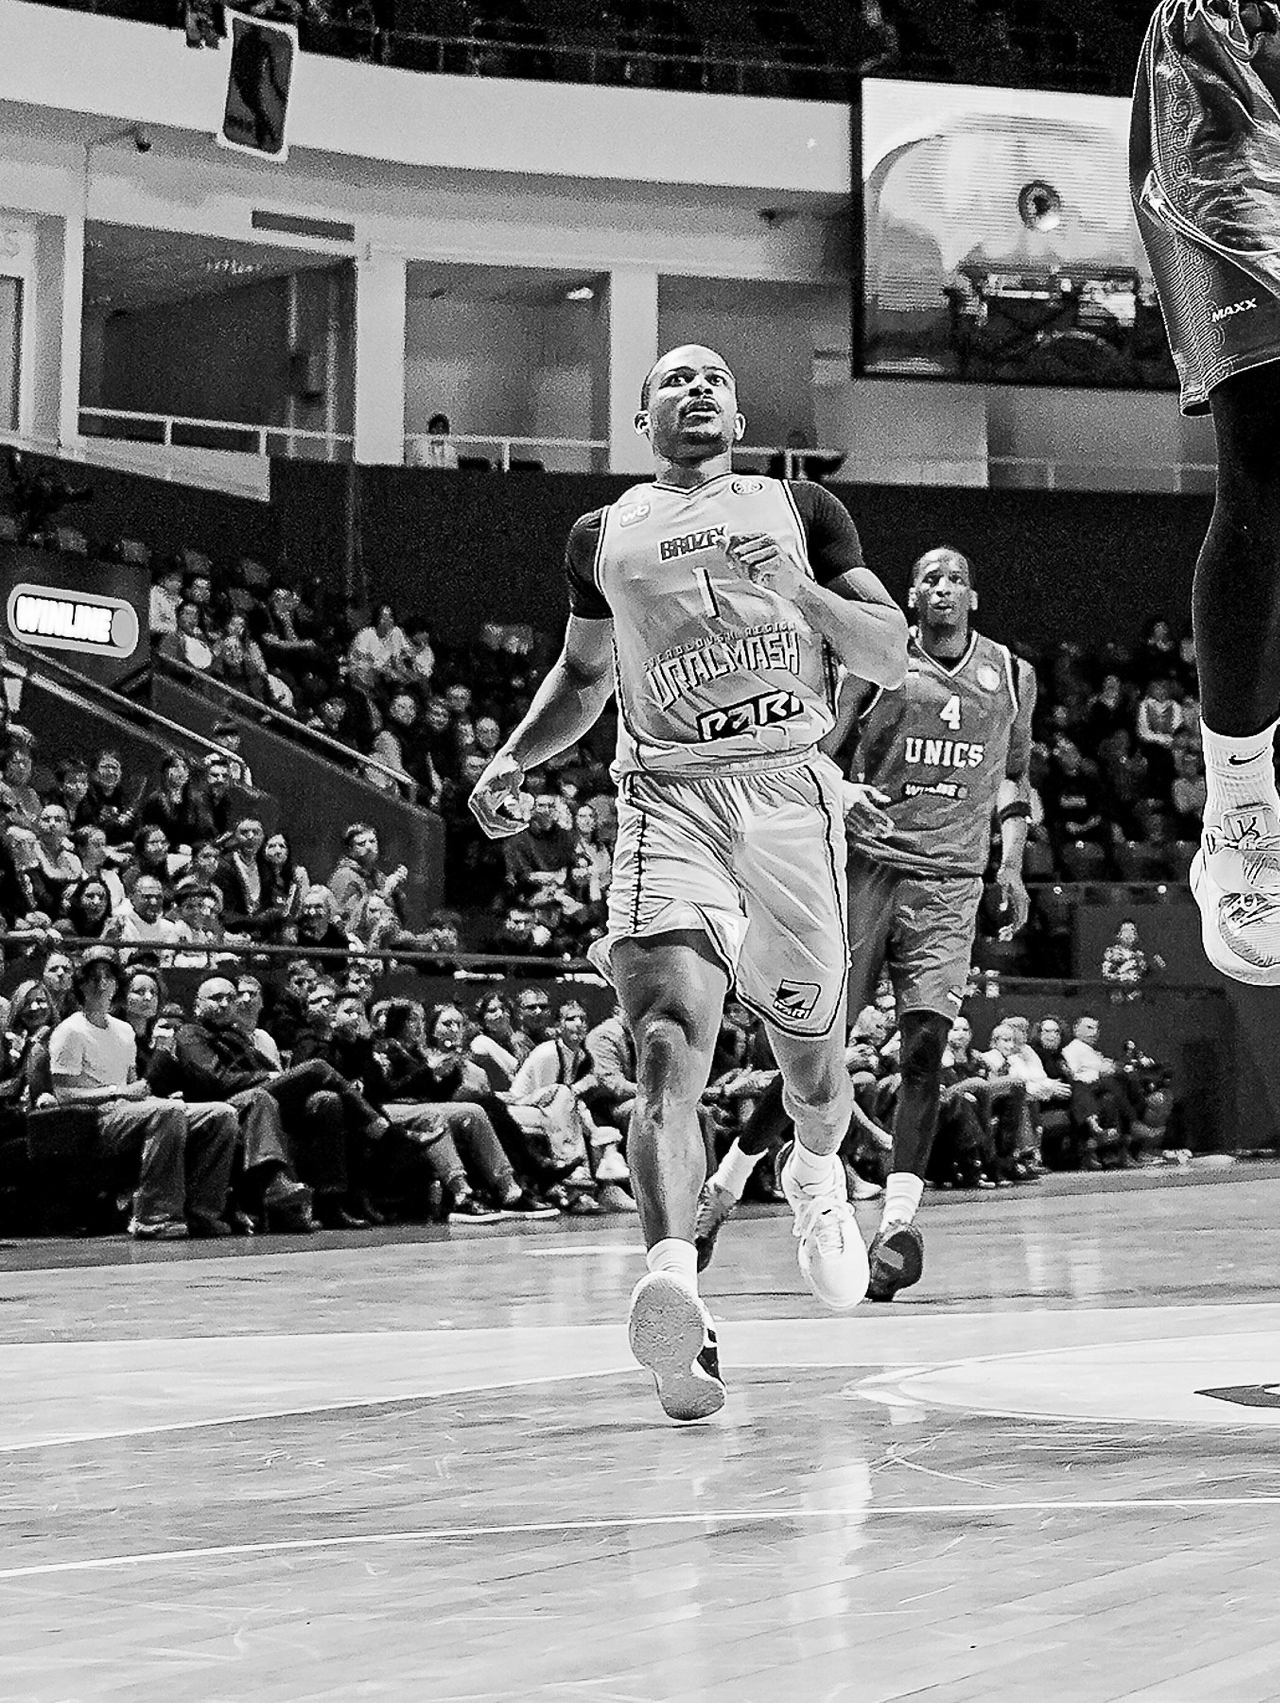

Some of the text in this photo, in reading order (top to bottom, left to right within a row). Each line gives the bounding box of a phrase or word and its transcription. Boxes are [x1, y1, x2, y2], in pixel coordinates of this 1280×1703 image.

[16, 595, 113, 644] WINLINE
[647, 632, 800, 711] URALMASH
[939, 694, 961, 731] 4
[904, 737, 985, 769] UNICS
